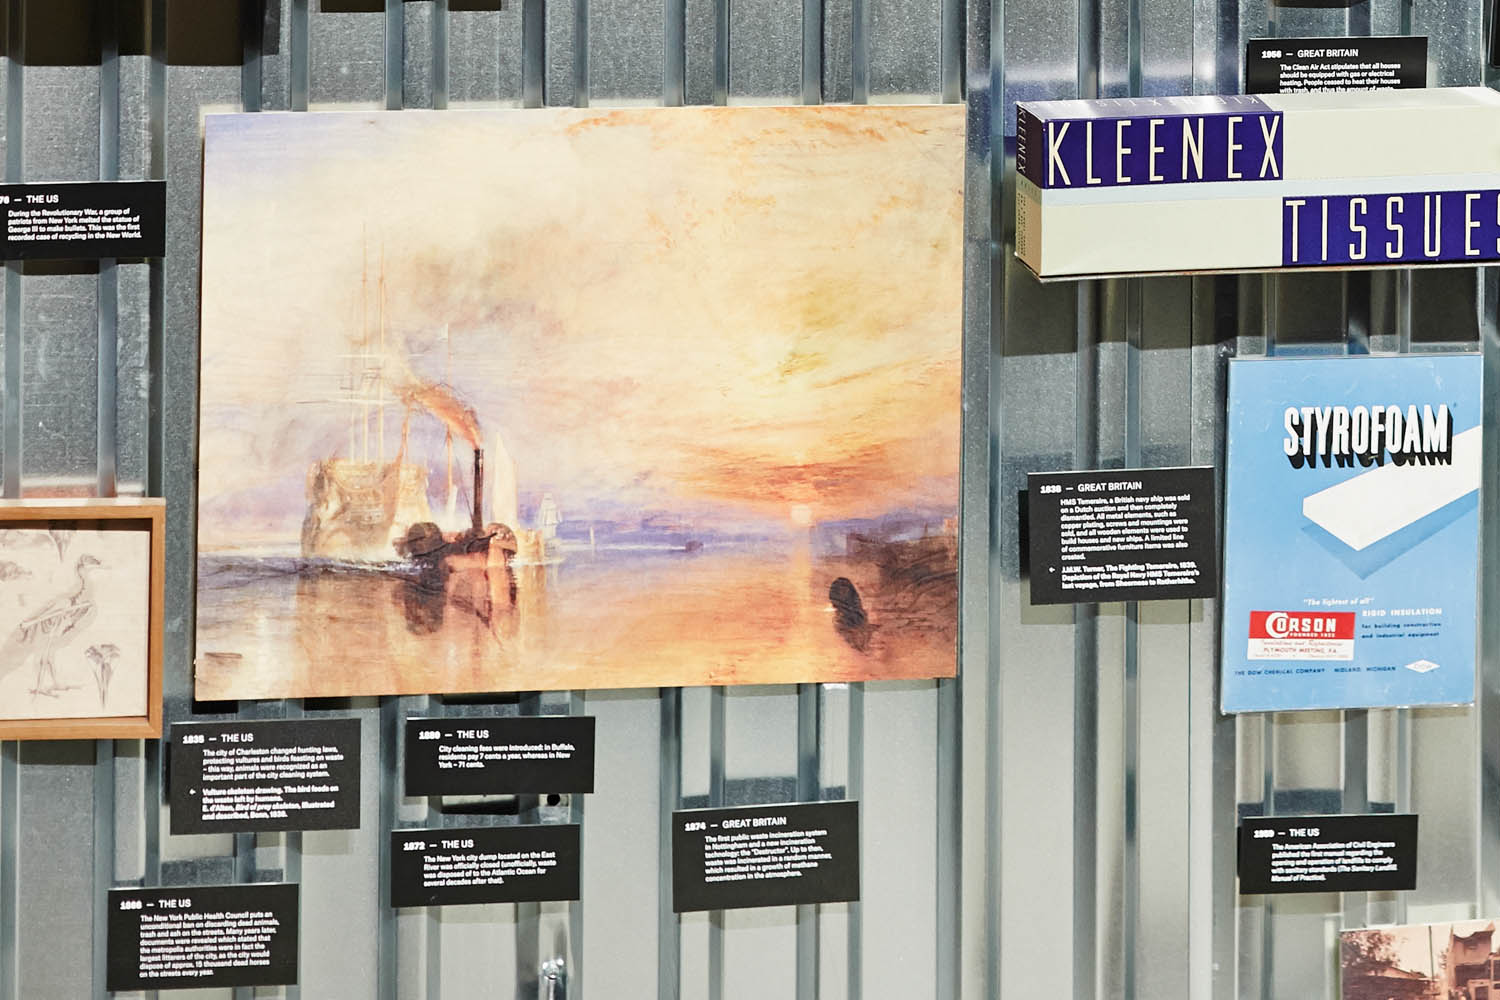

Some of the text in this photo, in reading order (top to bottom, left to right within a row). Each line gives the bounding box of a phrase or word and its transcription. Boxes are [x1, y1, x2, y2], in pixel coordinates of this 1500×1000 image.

[1018, 108, 1027, 175] KLEENEX
[1048, 115, 1280, 186] KLEENEX
[1283, 404, 1451, 460] STYROFOAM
[1322, 597, 1349, 606] lightest
[1350, 597, 1358, 605] of
[1361, 608, 1443, 617] RIGID INSULATION
[1265, 612, 1337, 638] CORSON
[722, 819, 751, 829] GREAT
[753, 817, 786, 827] BRITAIN
[441, 840, 459, 849] THE
[461, 839, 474, 848] US
